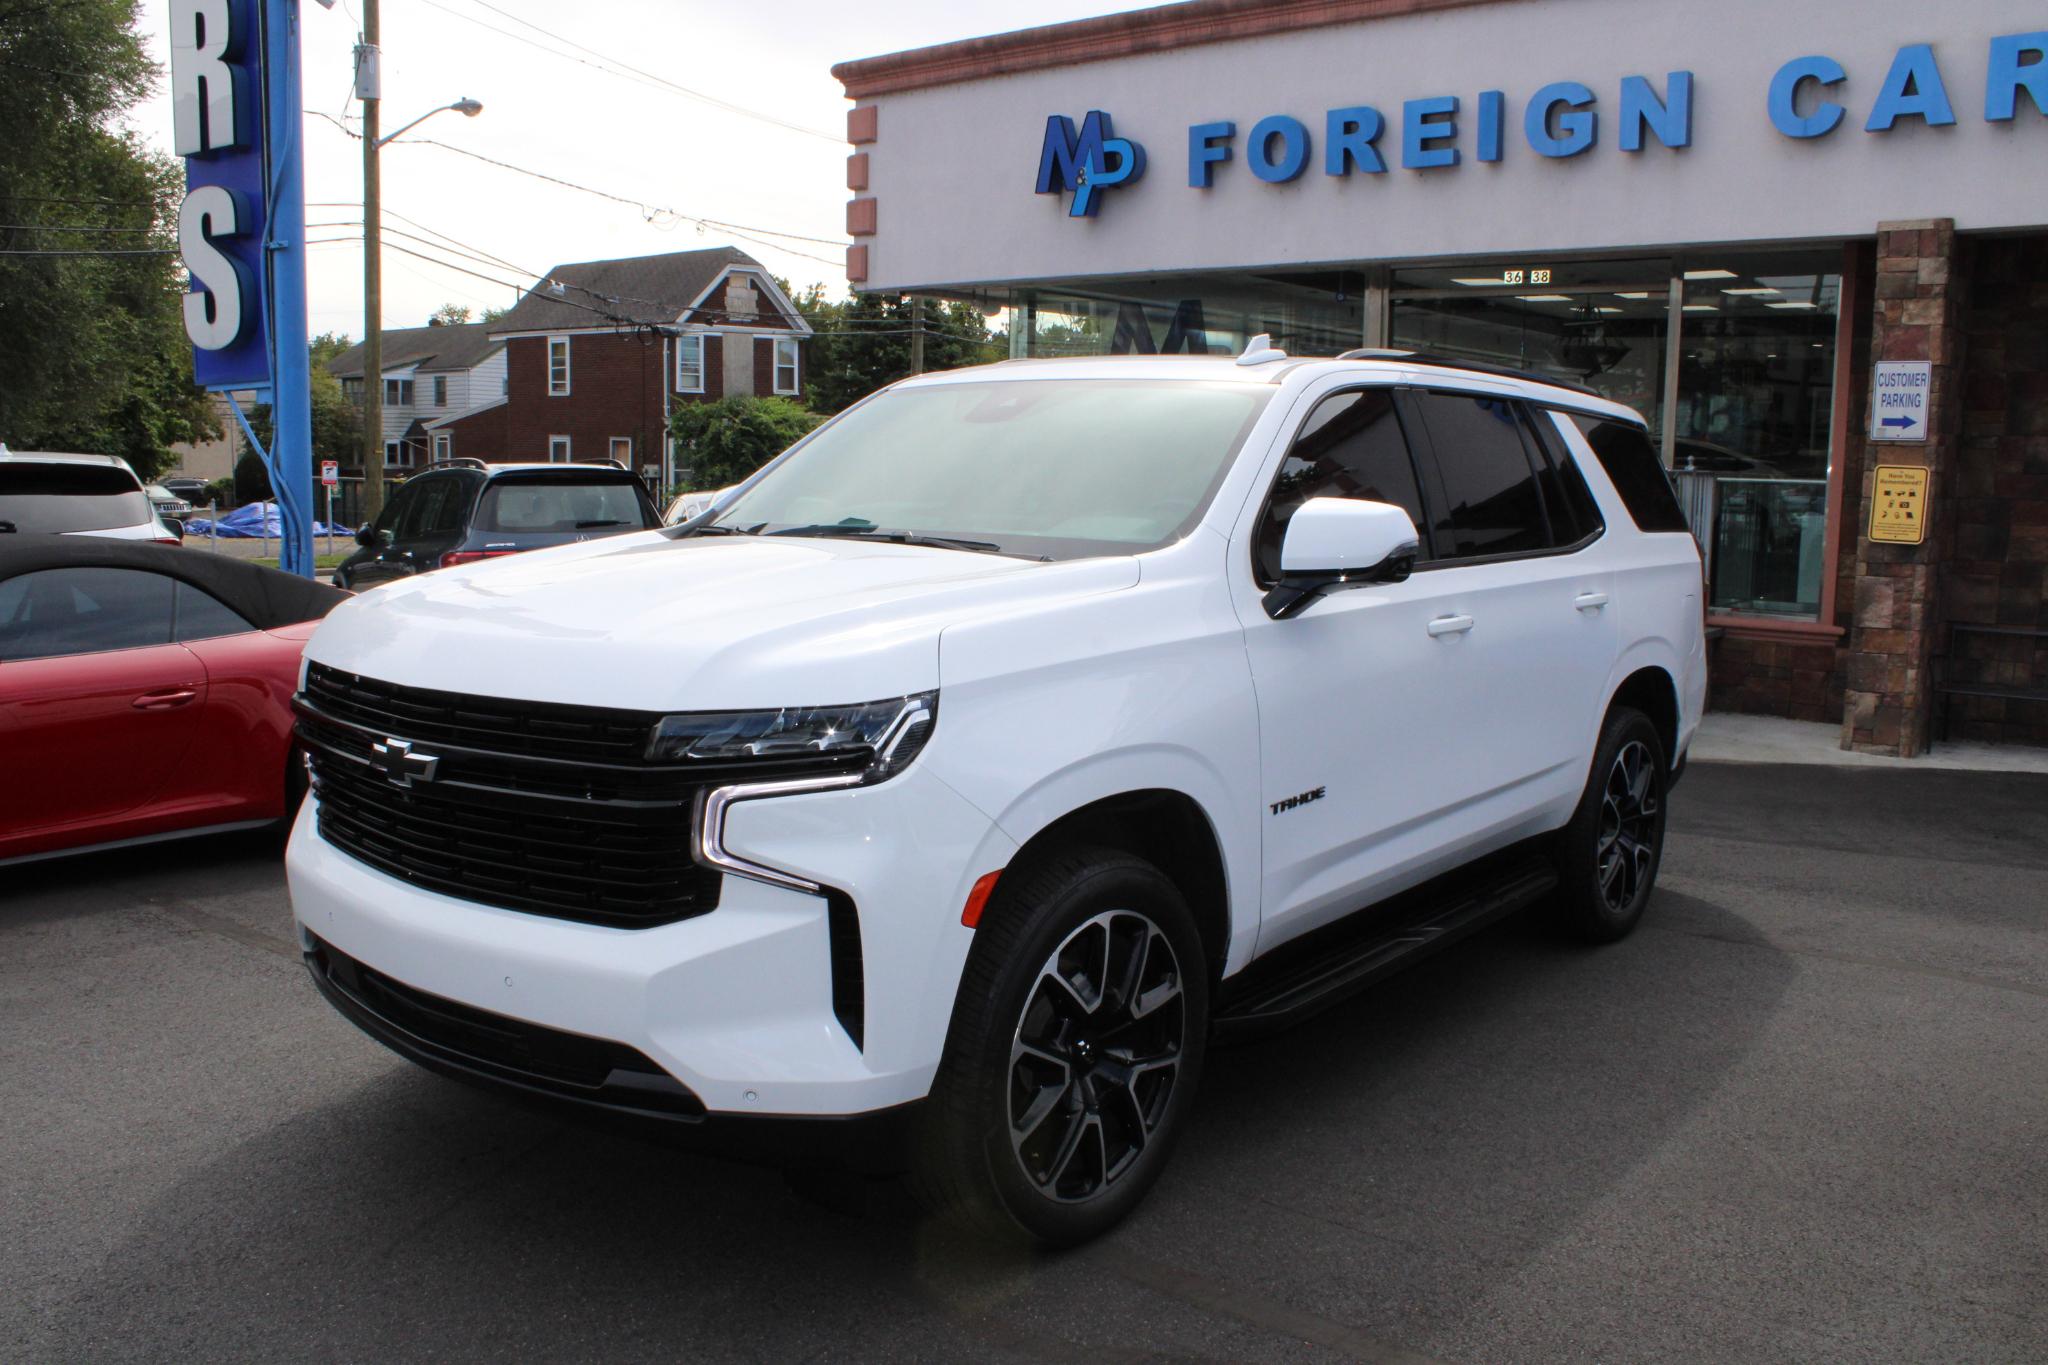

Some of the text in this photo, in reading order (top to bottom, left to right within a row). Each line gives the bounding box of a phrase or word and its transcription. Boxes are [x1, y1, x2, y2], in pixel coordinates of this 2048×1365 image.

[1188, 70, 1694, 188] FOREIGN
[1767, 31, 2048, 139] CAR
[1504, 270, 1550, 283] 36 38
[1878, 373, 1927, 387] CUSTOMER
[1881, 393, 1921, 408] PARKING
[1269, 786, 1326, 816] TAHOE
